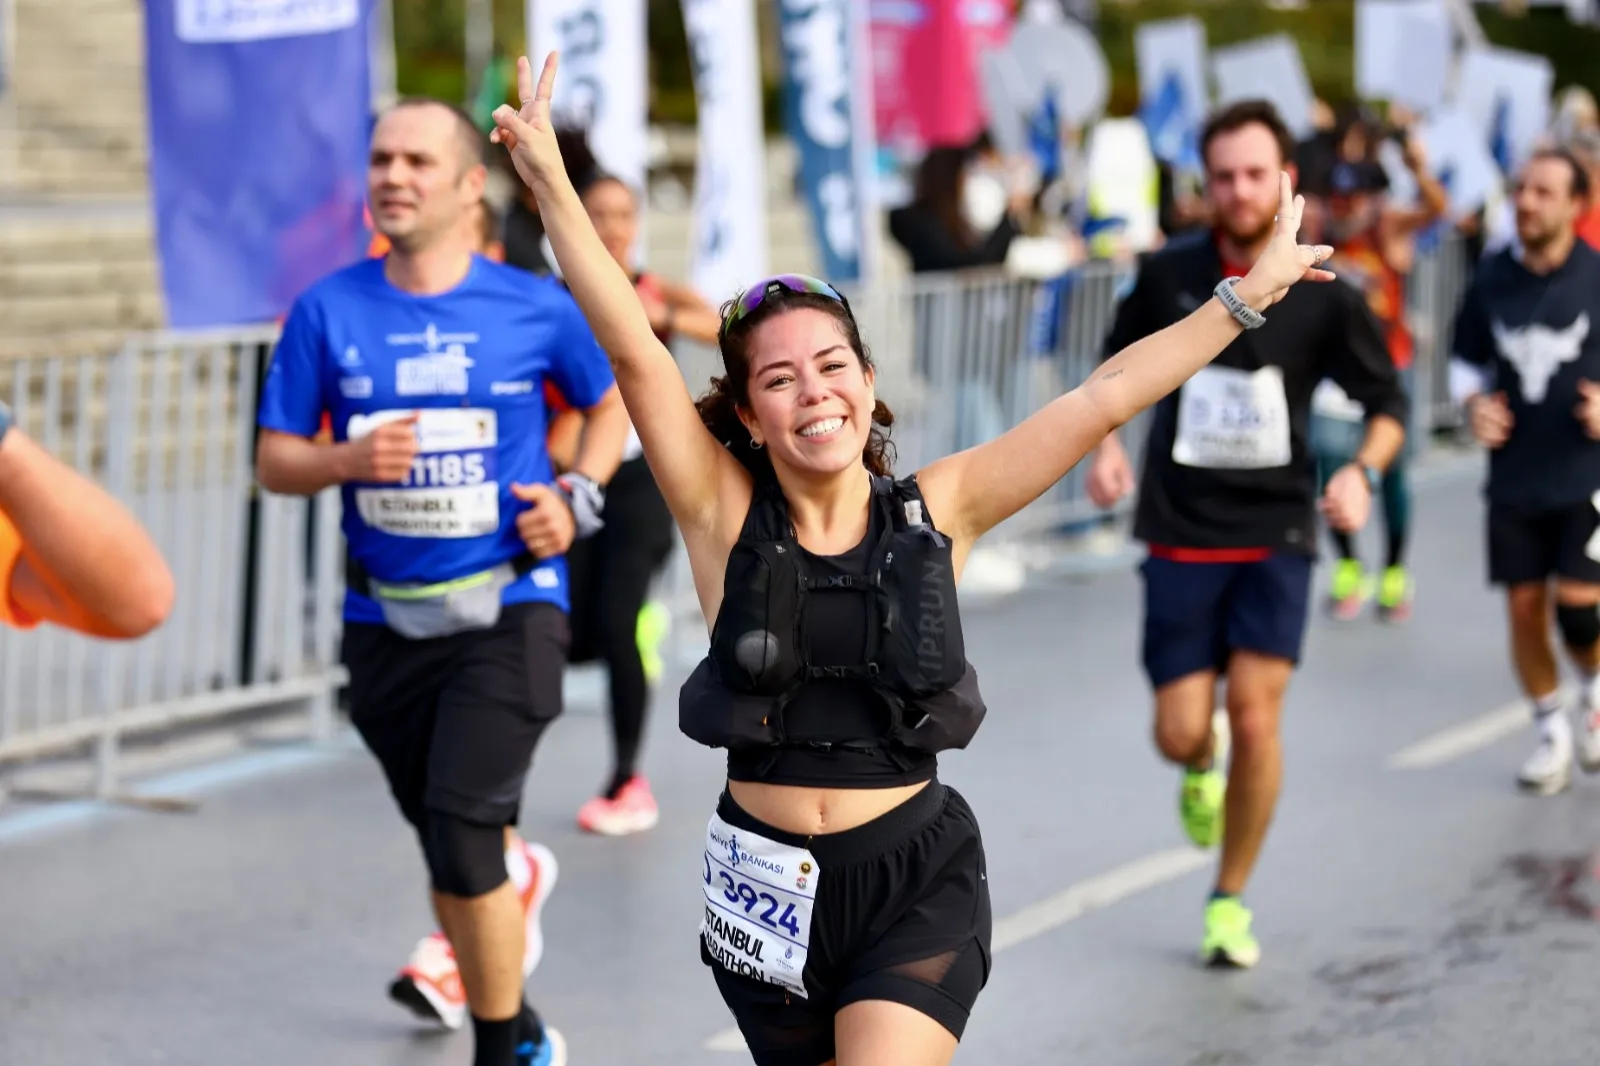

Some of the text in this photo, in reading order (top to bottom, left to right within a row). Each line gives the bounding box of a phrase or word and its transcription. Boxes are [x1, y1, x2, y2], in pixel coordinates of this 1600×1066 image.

[914, 560, 945, 692] KIPRUN
[741, 853, 784, 875] BANKASI
[704, 904, 764, 963] STANBUL
[719, 870, 800, 938] 3924
